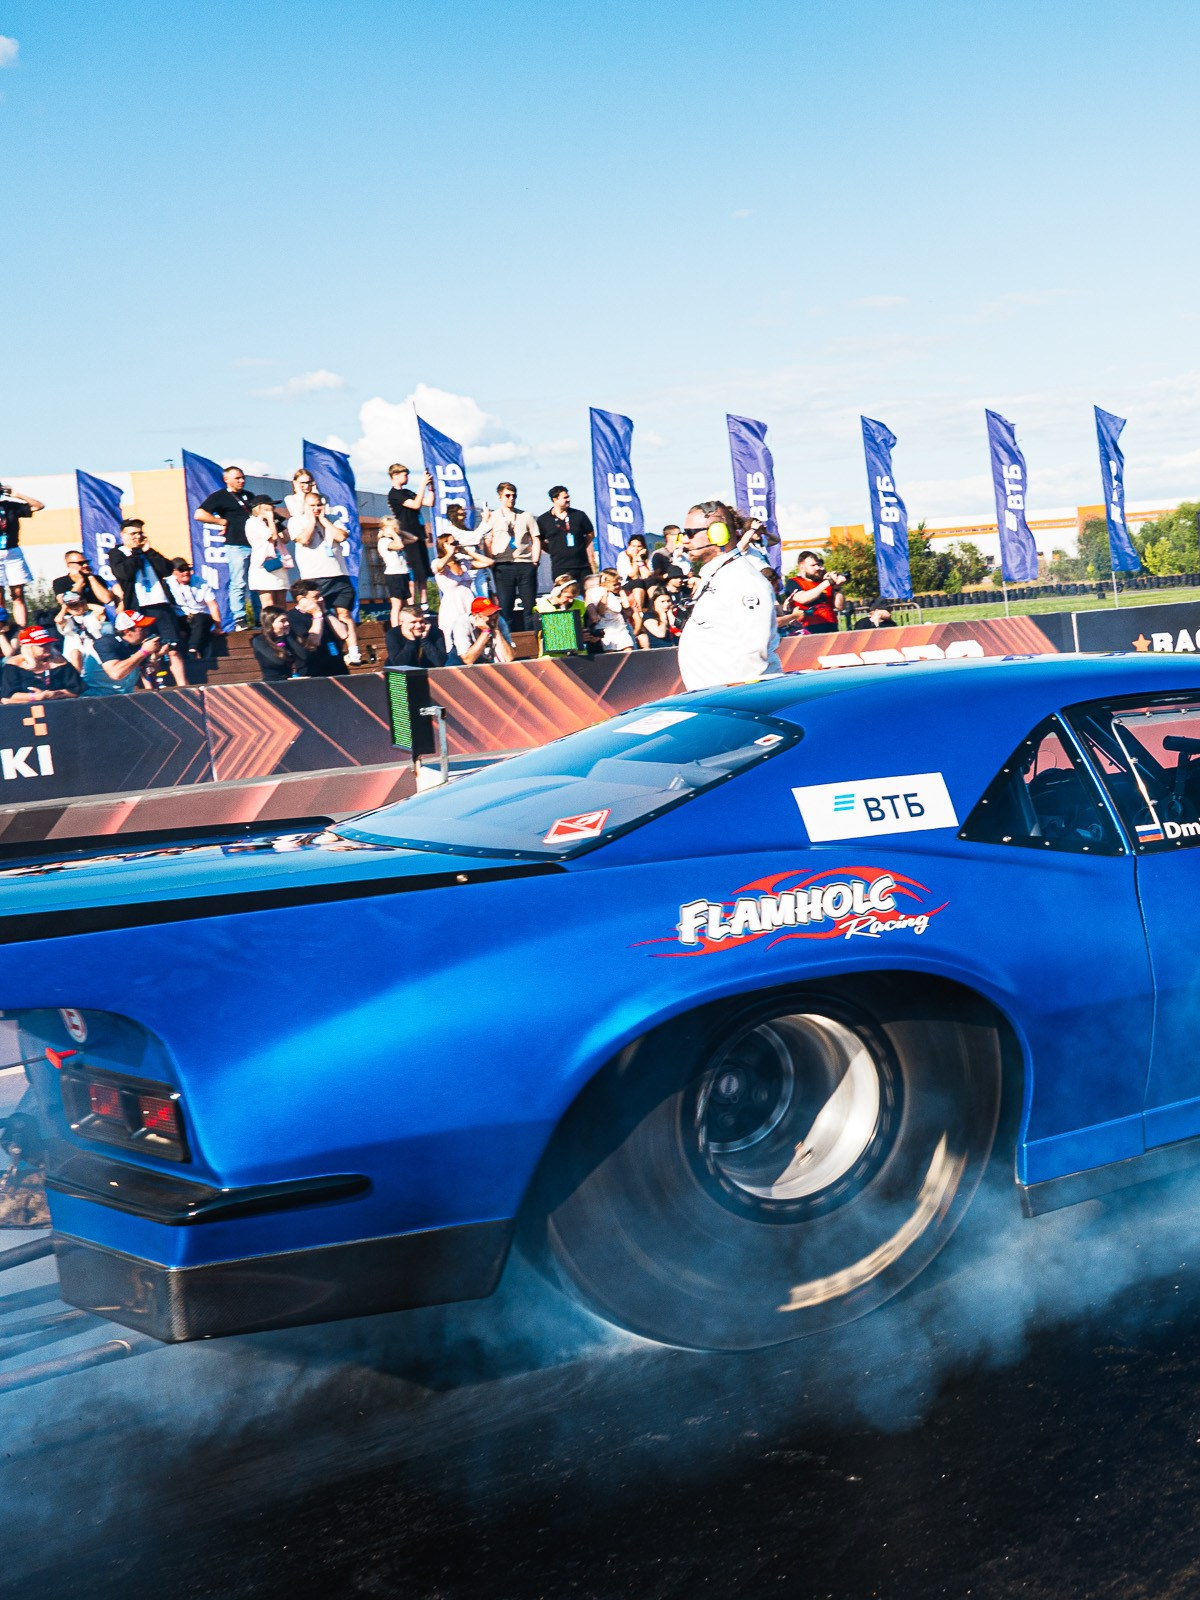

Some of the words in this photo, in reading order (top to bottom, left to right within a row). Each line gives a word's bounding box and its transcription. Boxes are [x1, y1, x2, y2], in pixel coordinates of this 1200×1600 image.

[607, 473, 634, 523] ВТБ
[747, 471, 769, 522] ВТБ
[876, 475, 900, 523] ВТБ
[1002, 464, 1025, 510] ВТБ
[862, 792, 926, 822] ВТБ
[838, 914, 931, 941] Racing
